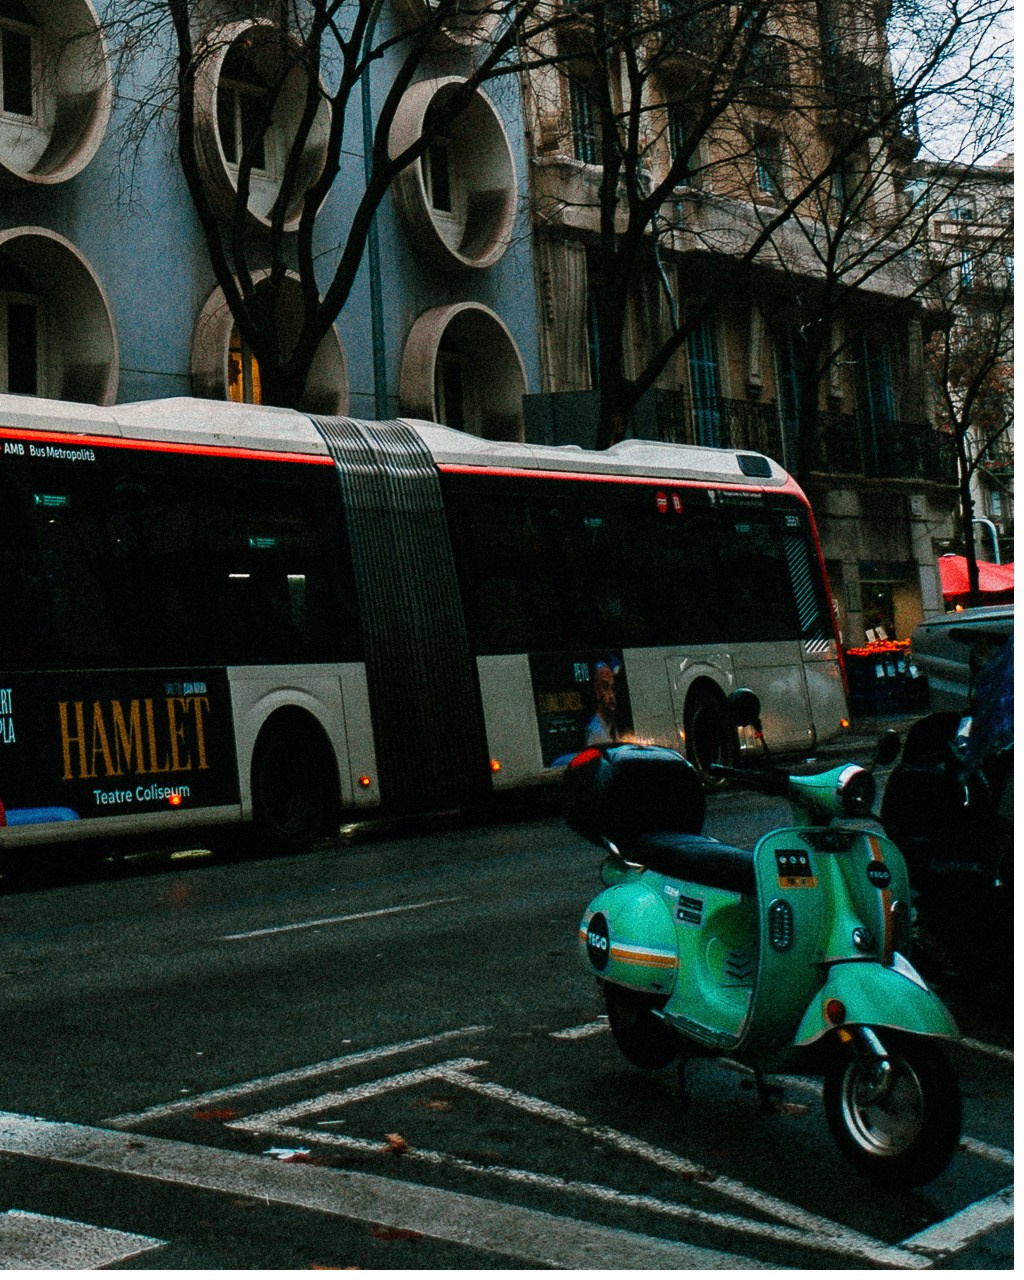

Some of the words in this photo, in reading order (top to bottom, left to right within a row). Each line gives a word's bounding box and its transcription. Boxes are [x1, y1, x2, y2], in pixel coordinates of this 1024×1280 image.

[4, 442, 25, 456] AMB
[29, 444, 46, 457] Bus
[46, 446, 96, 462] Metropolità
[59, 696, 210, 781] HAMLET
[93, 787, 133, 805] Teatre
[135, 783, 191, 802] Coliseum
